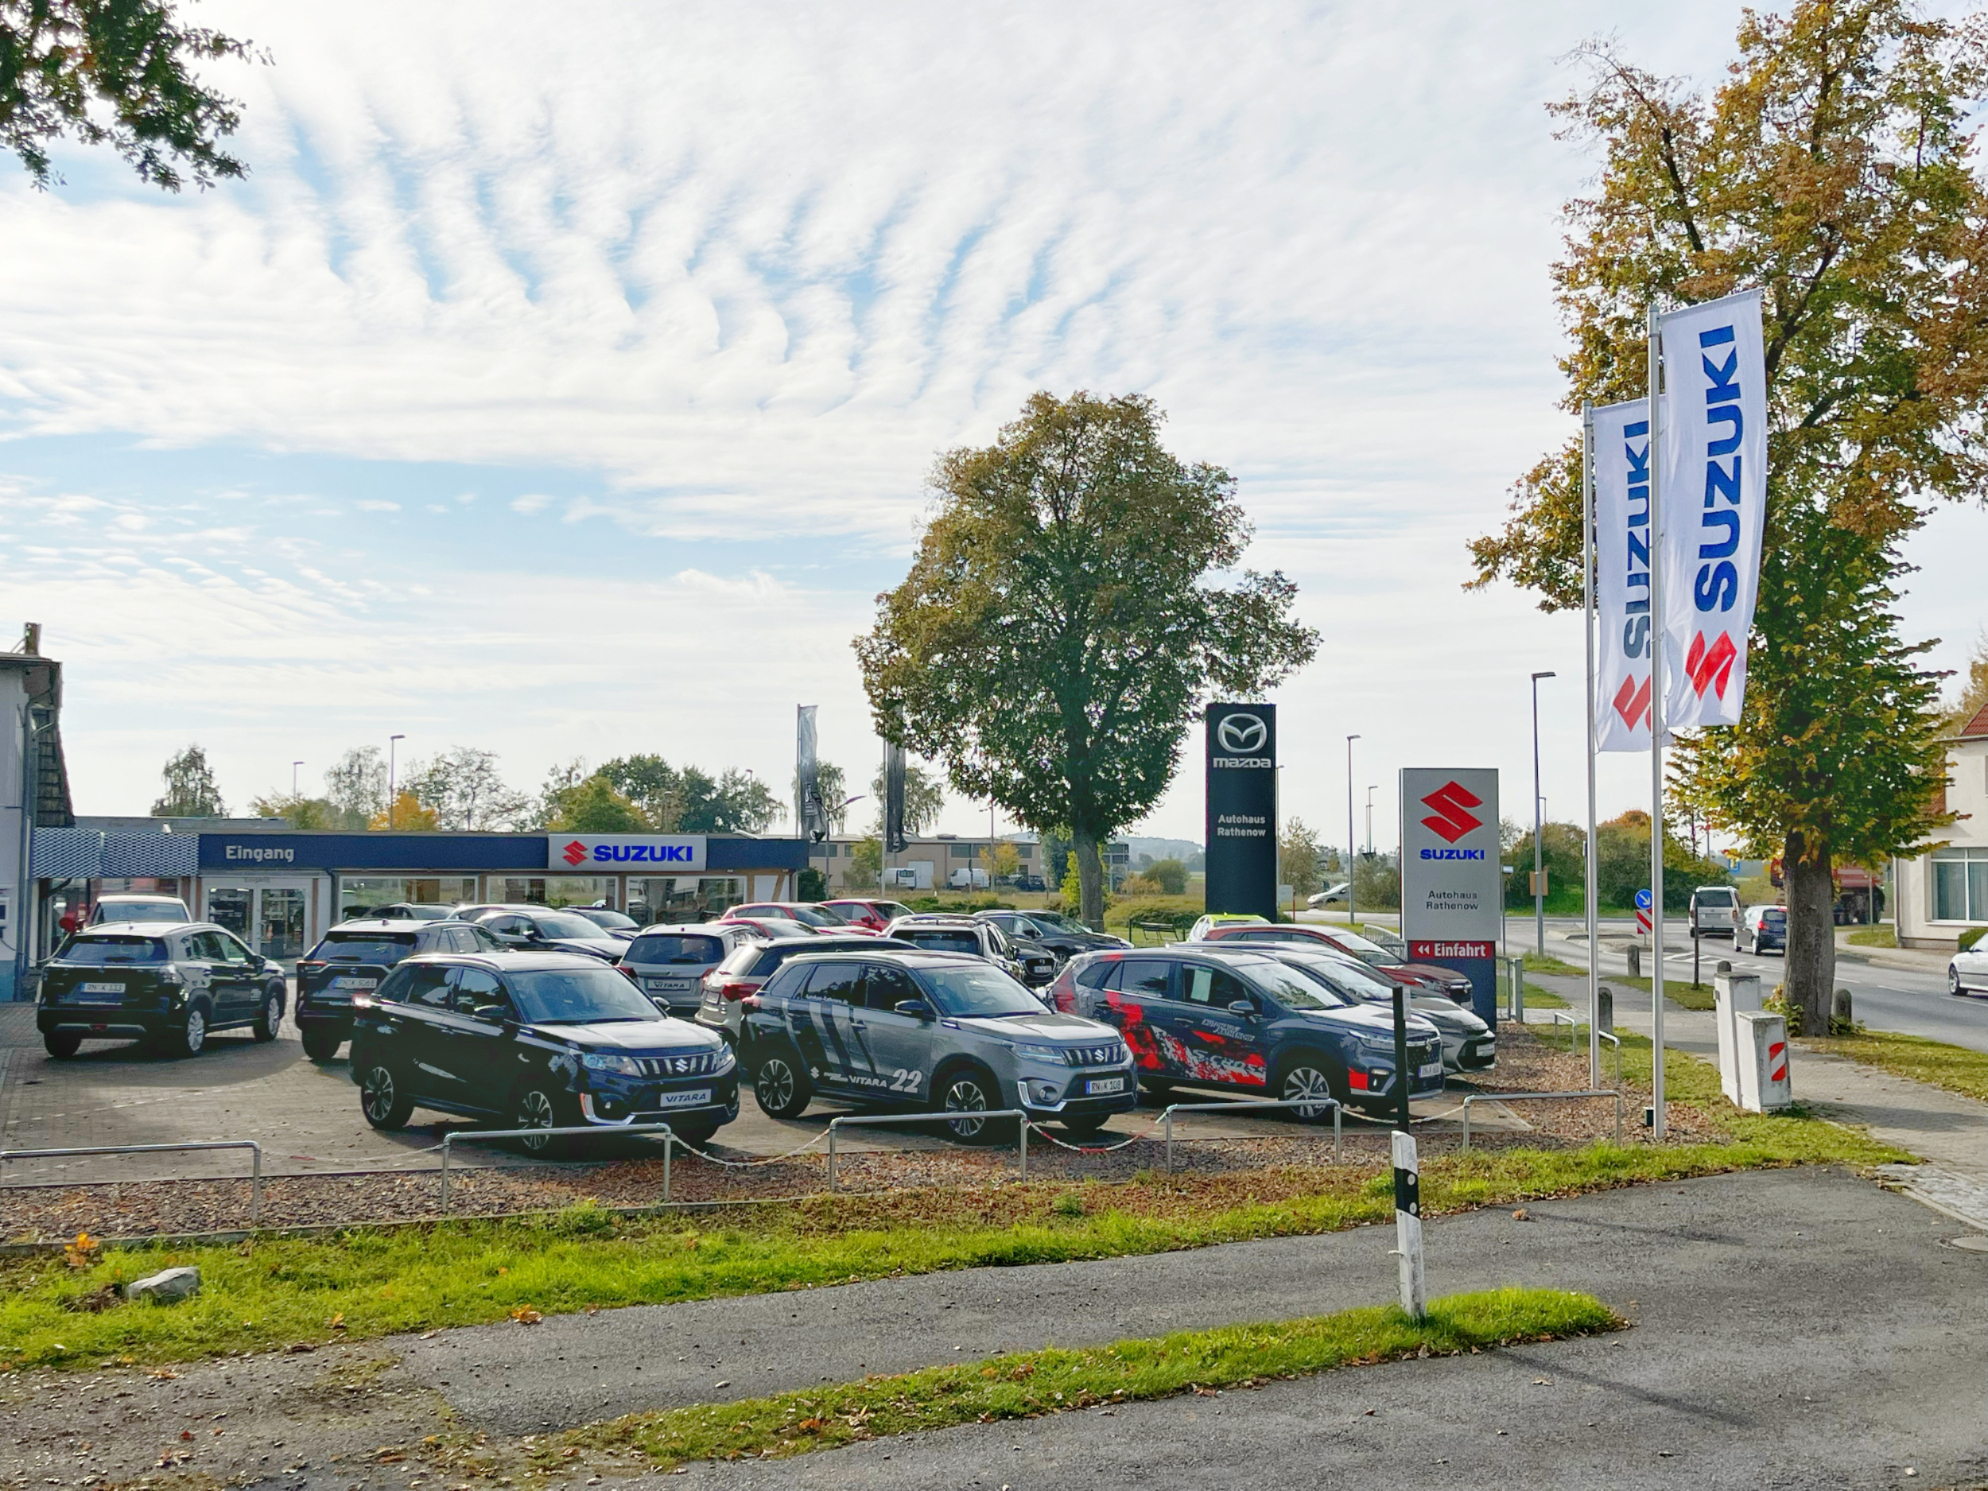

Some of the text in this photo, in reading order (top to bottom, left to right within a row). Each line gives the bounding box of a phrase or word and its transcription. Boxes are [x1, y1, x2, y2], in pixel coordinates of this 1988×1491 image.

[1694, 325, 1743, 612] SUZUKI
[1218, 814, 1266, 824] Autohaus
[1217, 827, 1266, 837] Rathenow
[225, 845, 295, 862] Eingang
[593, 845, 693, 862] SUZUKI
[1420, 849, 1485, 860] SUZUKI
[1428, 890, 1478, 899] Autohaus
[1426, 901, 1479, 910] Rathenow
[1434, 943, 1486, 957] Einfahrt
[849, 1075, 887, 1088] VITARA
[889, 1068, 922, 1094] 22
[665, 1093, 706, 1103] VITARA
